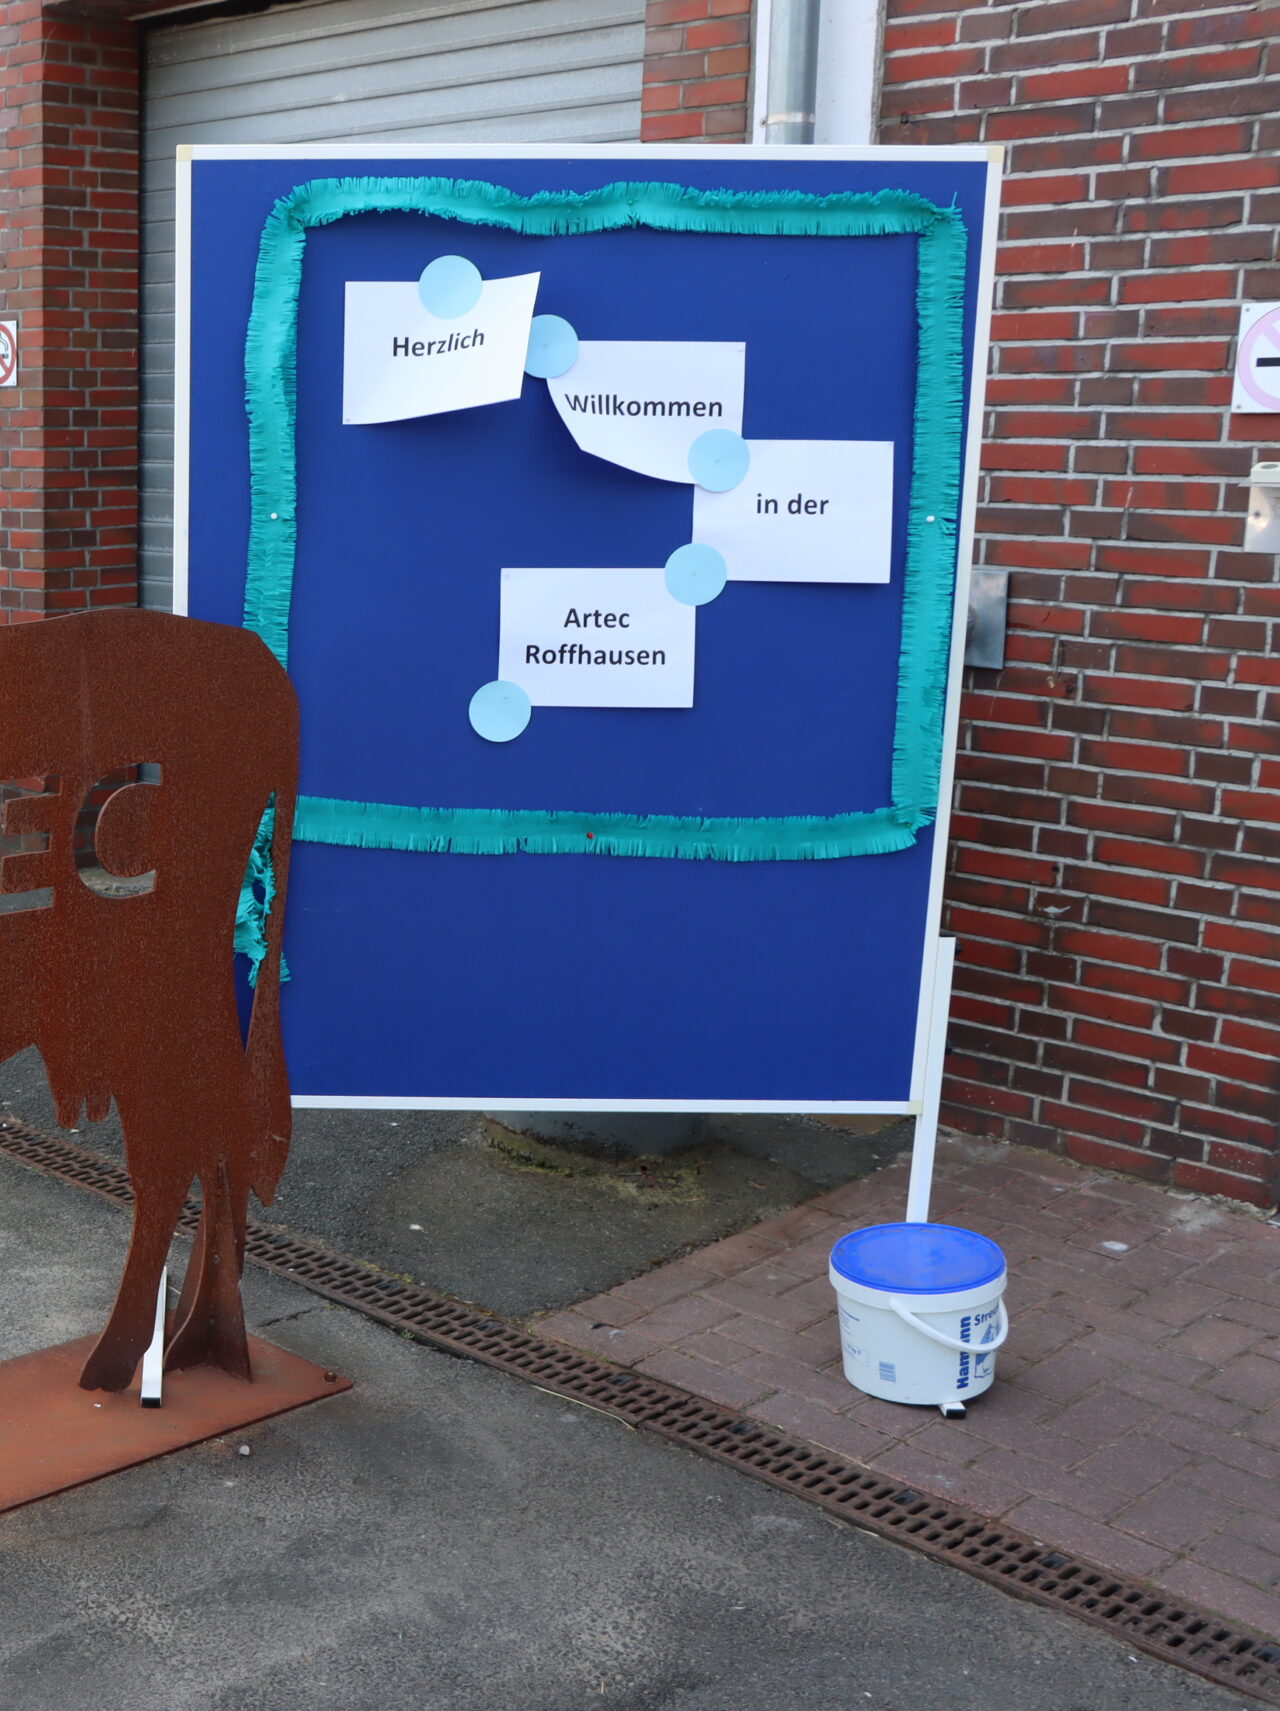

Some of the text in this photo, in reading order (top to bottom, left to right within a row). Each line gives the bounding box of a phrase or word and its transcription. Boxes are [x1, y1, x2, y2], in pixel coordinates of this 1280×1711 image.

[392, 328, 485, 358] Herzlich
[564, 393, 724, 418] Willkommen
[756, 493, 830, 516] in der
[563, 607, 631, 630] Artec
[524, 642, 667, 667] Roffhausen
